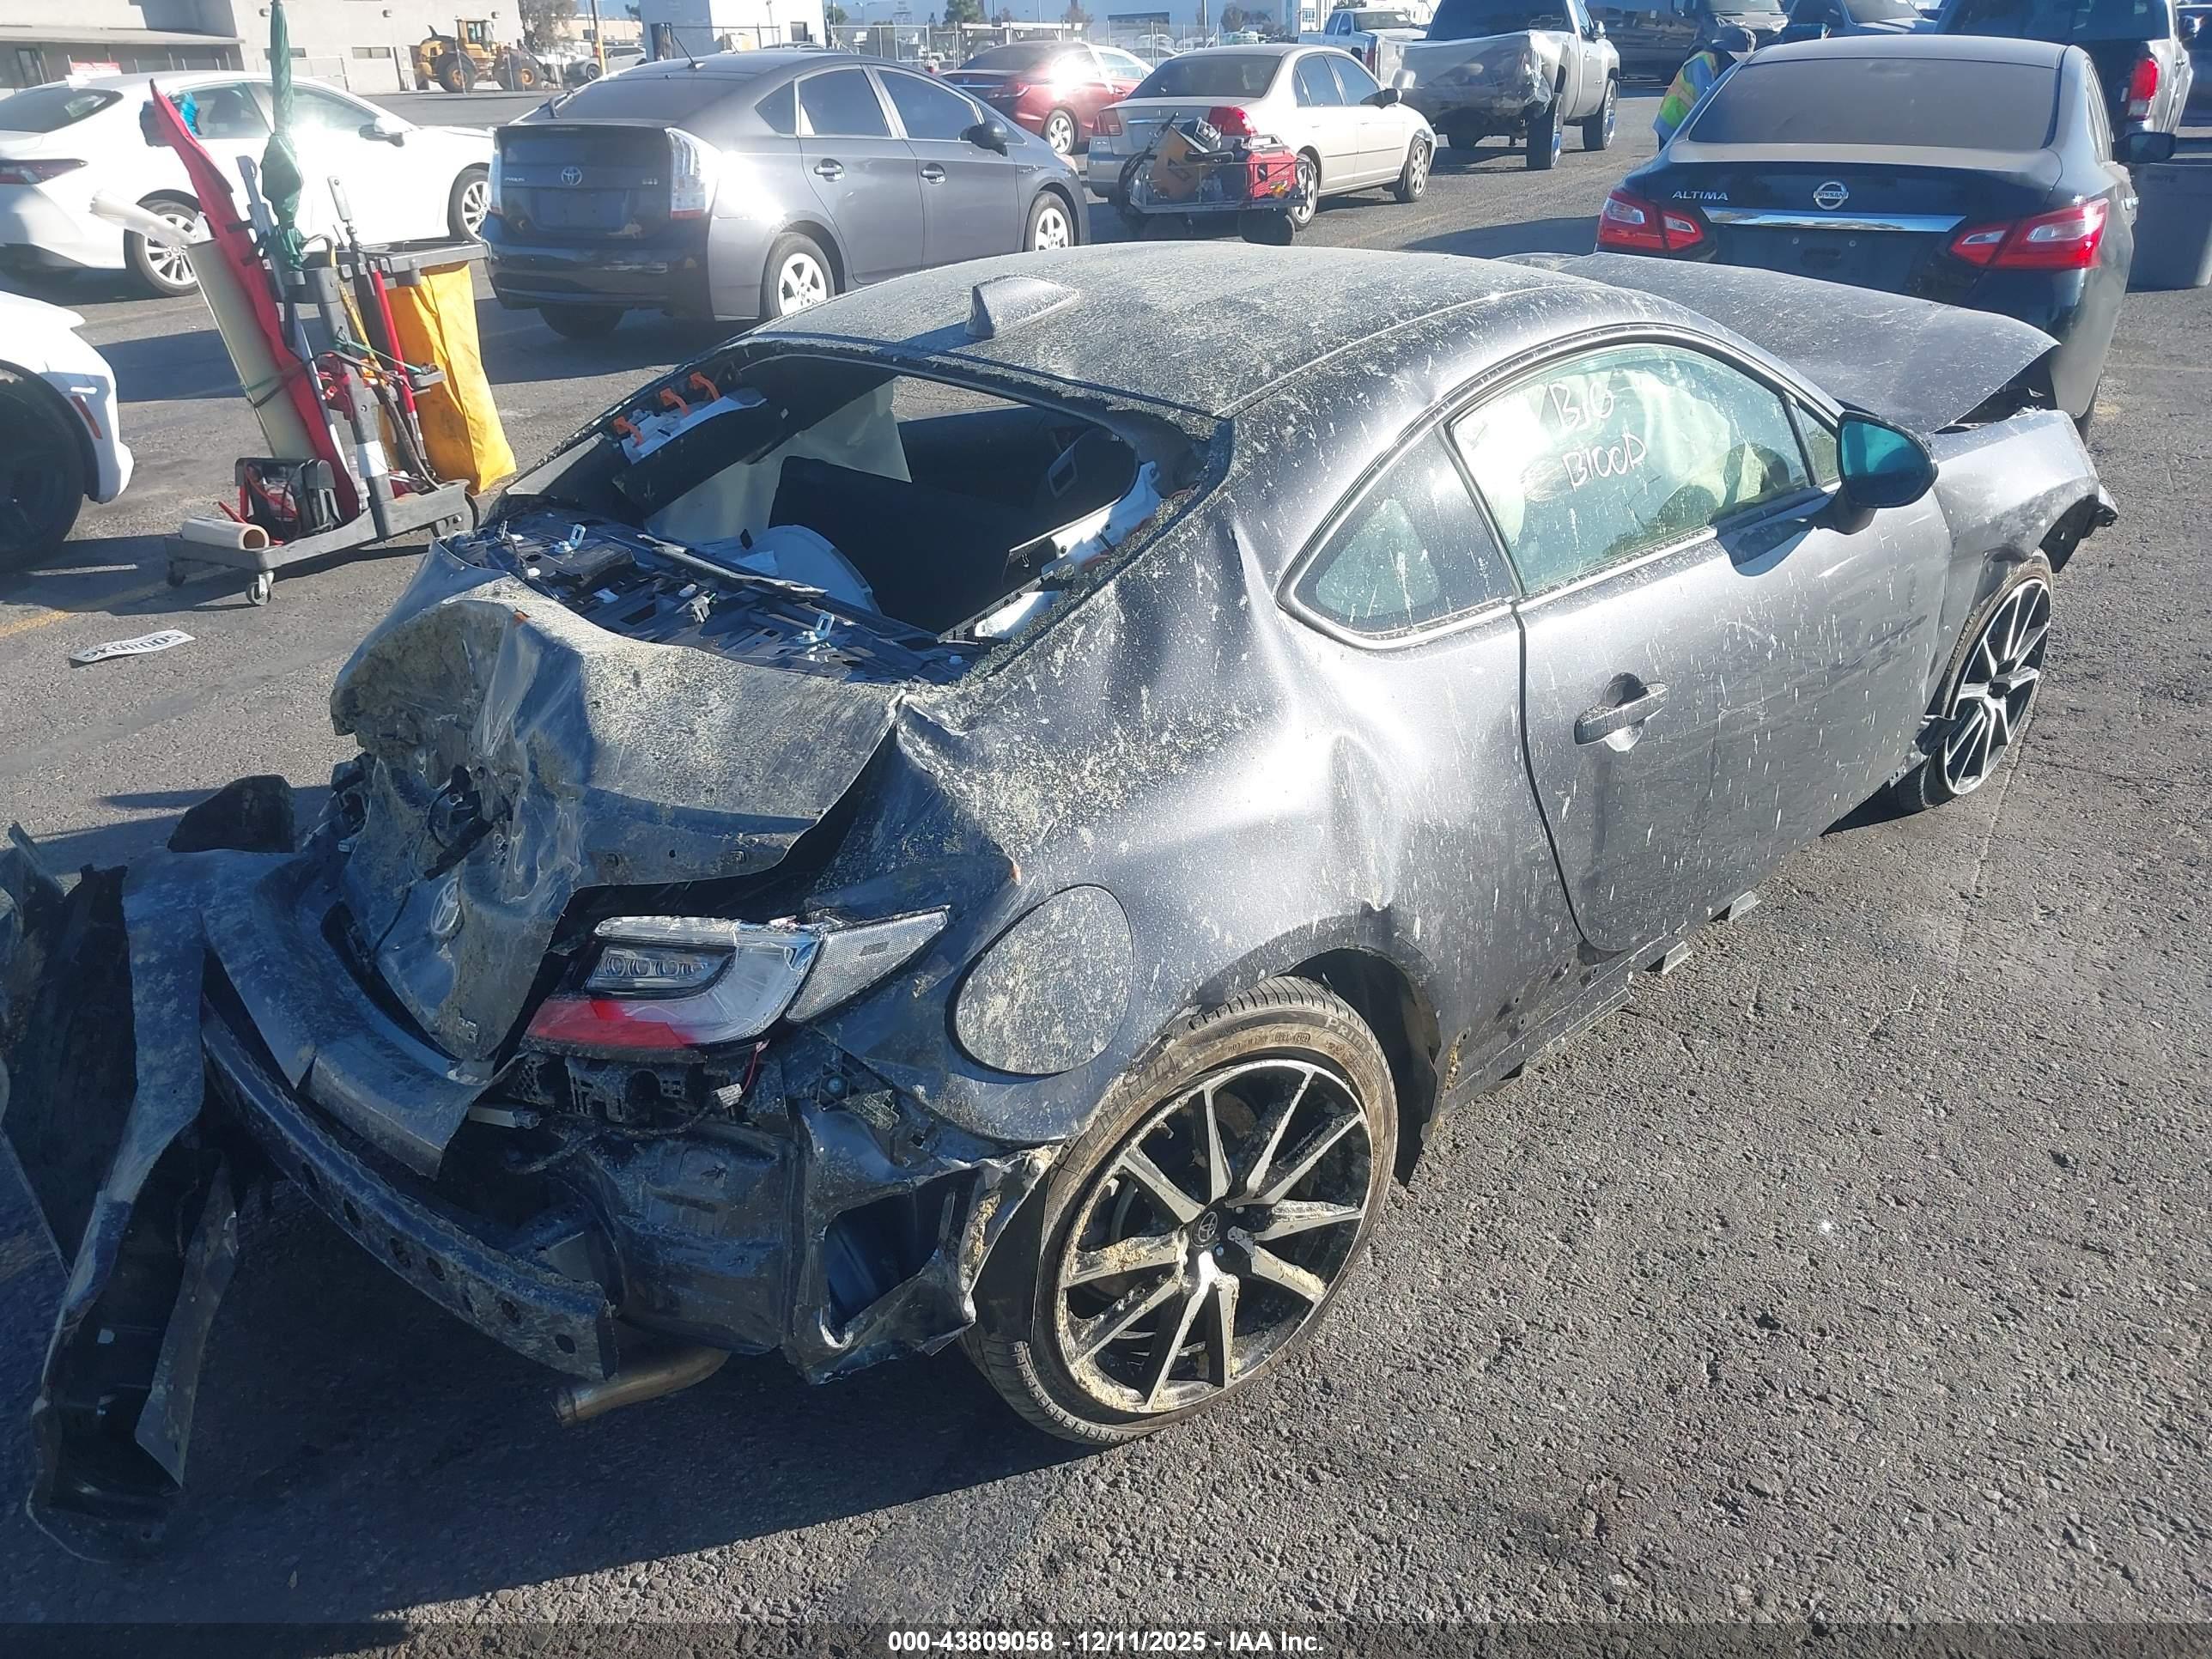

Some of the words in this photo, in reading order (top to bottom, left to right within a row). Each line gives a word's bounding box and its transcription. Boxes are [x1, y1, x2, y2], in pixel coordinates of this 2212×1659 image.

[1671, 190, 1729, 201] ALTIMA
[1816, 191, 1845, 199] NISSAN
[1547, 382, 1614, 430] BIG
